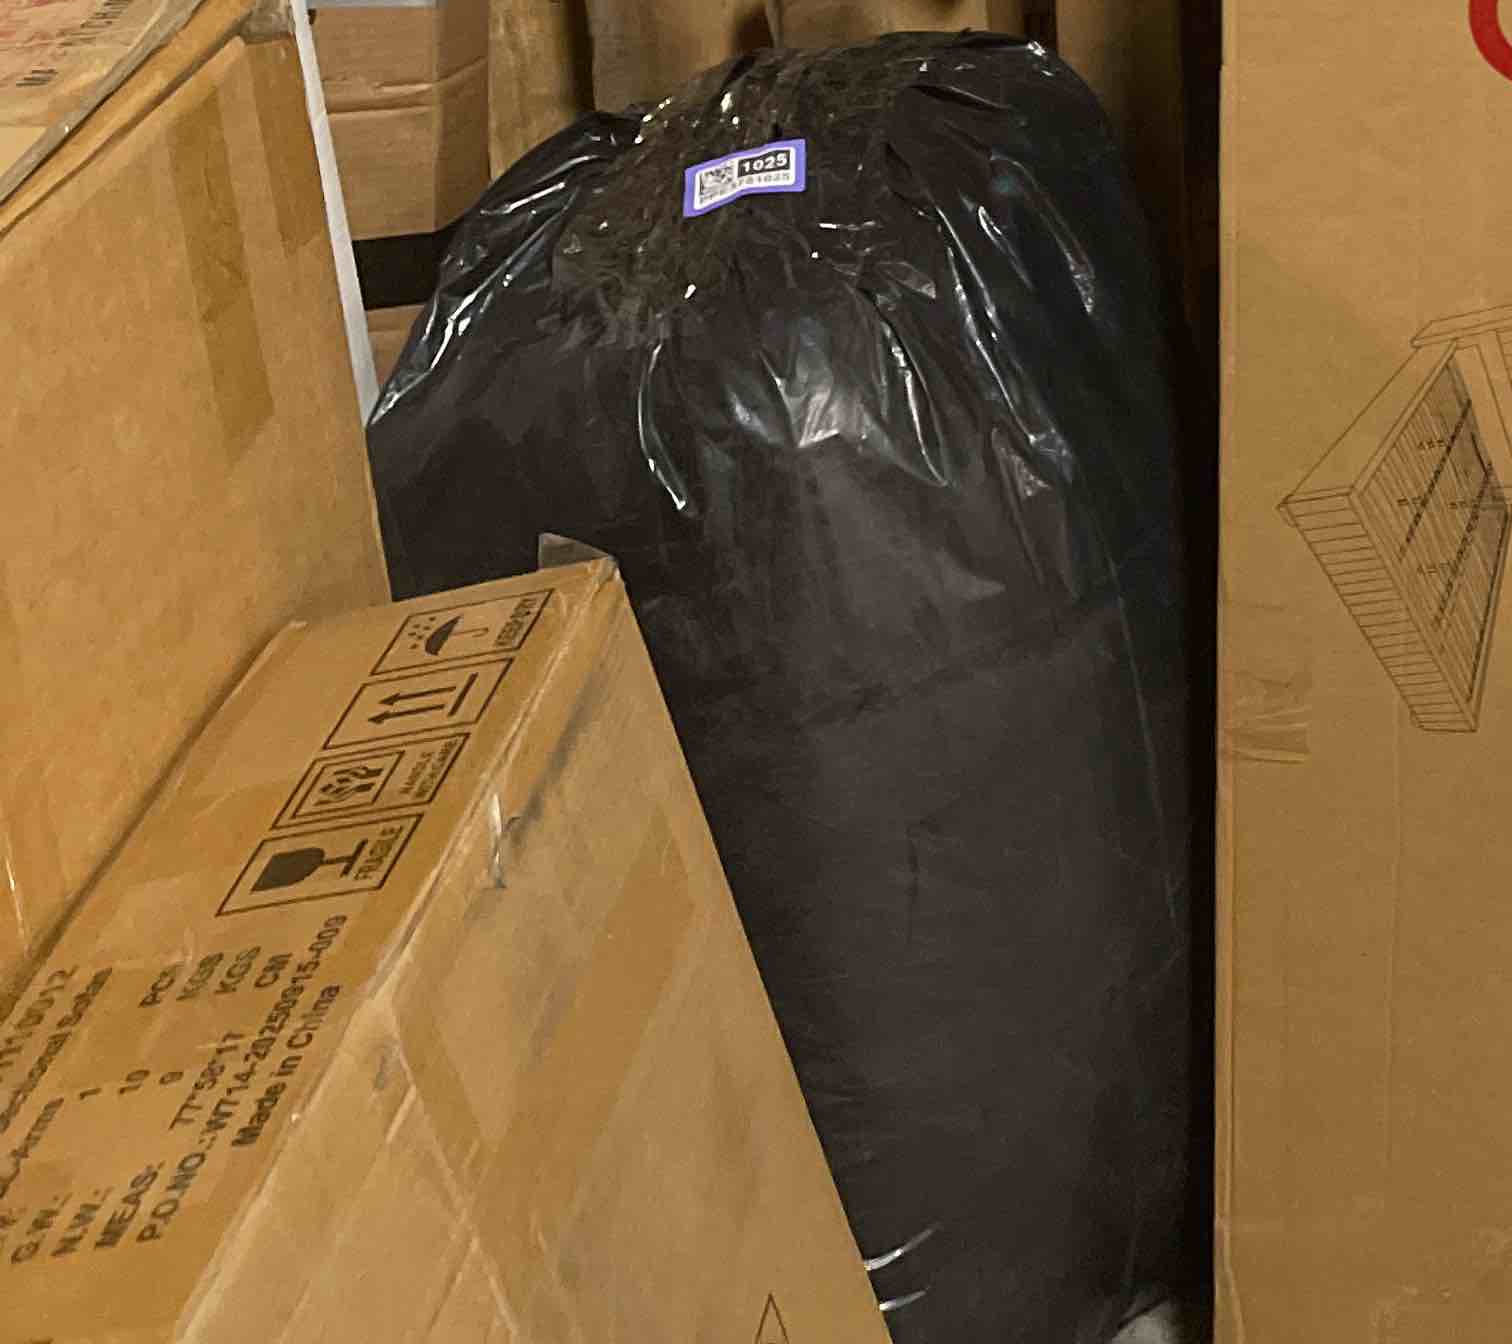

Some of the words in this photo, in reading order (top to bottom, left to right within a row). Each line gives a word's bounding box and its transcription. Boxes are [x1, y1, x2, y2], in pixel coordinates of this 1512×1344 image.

[742, 153, 788, 172] 1025
[354, 825, 403, 880] FRAGILE
[215, 946, 262, 995] KGS
[254, 952, 293, 990] CM
[118, 1069, 151, 1095] 10
[176, 953, 224, 1001] KGS
[286, 984, 341, 1050] China
[270, 1055, 303, 1079] in
[231, 1081, 286, 1147] Made
